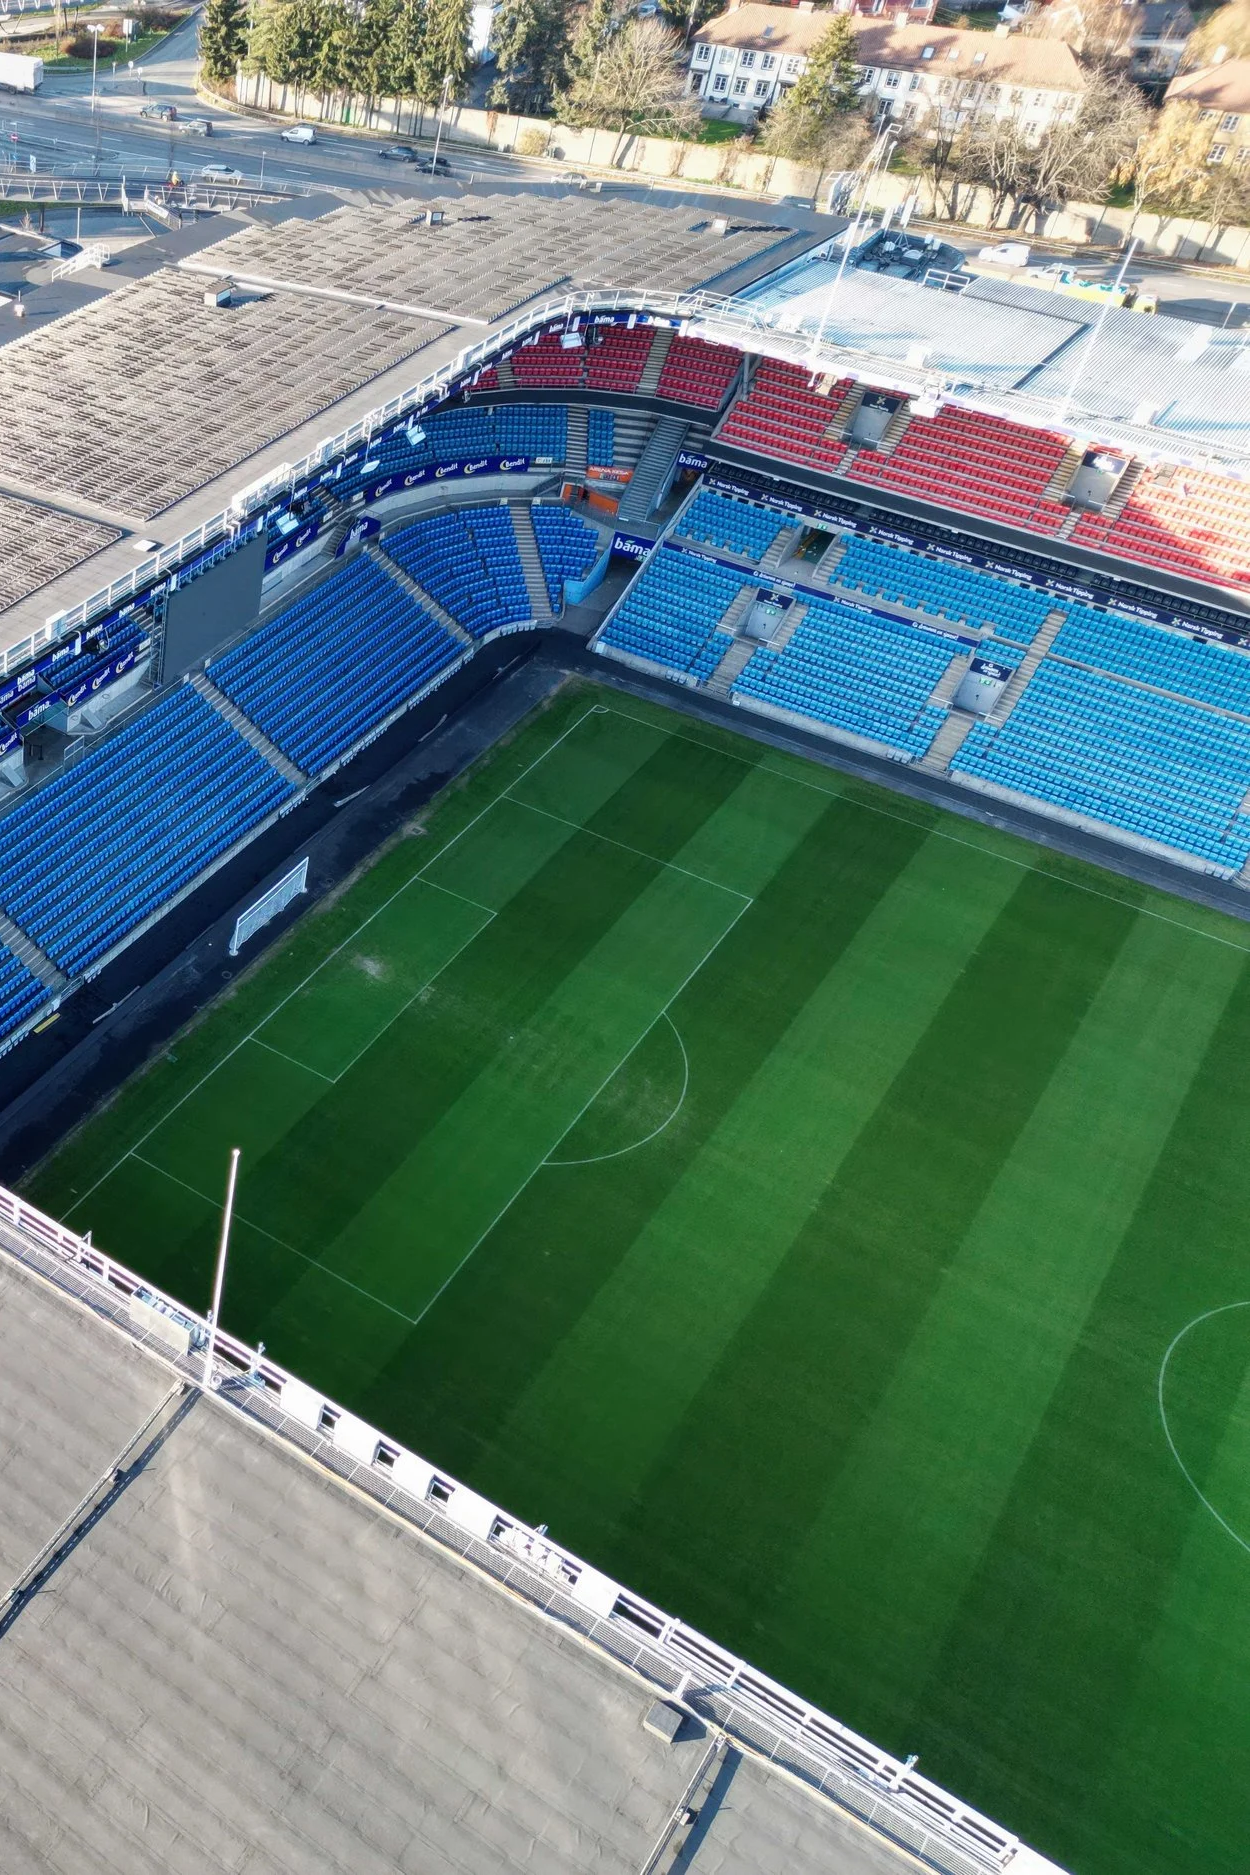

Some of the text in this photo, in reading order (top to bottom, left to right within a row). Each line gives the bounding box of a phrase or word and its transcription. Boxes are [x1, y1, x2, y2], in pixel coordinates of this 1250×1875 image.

[678, 453, 708, 469] bama
[614, 537, 650, 557] bama
[28, 701, 50, 721] bama
